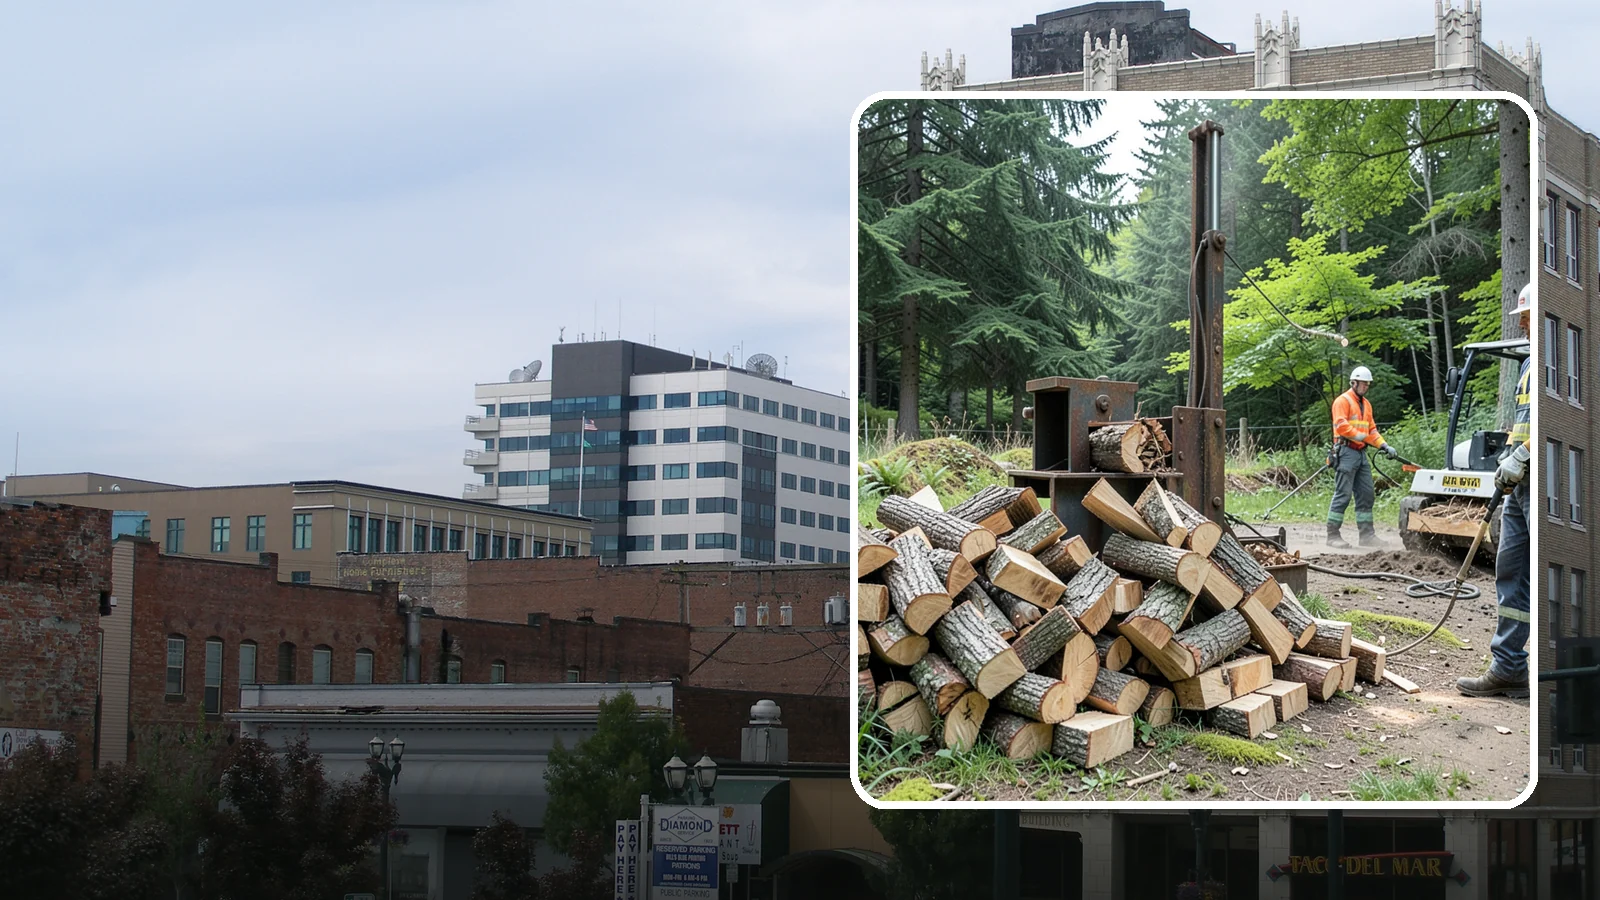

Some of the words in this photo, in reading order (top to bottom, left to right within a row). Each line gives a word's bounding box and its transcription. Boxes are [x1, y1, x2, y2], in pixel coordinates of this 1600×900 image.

[343, 568, 368, 576] Home
[370, 566, 427, 576] Furnishers
[660, 818, 713, 832] DIAMOND
[1022, 815, 1070, 827] BUILDING
[617, 825, 625, 852] PAY
[628, 825, 636, 852] PAY
[656, 845, 687, 853] RESERVED
[671, 862, 701, 870] PATRONS
[1289, 855, 1329, 874] TAC
[1345, 856, 1385, 875] DEL
[1392, 857, 1442, 877] MAR
[616, 856, 625, 894] HERE
[627, 855, 636, 894] HERE
[660, 889, 681, 897] PUBLIC
[684, 890, 710, 898] PARKING
